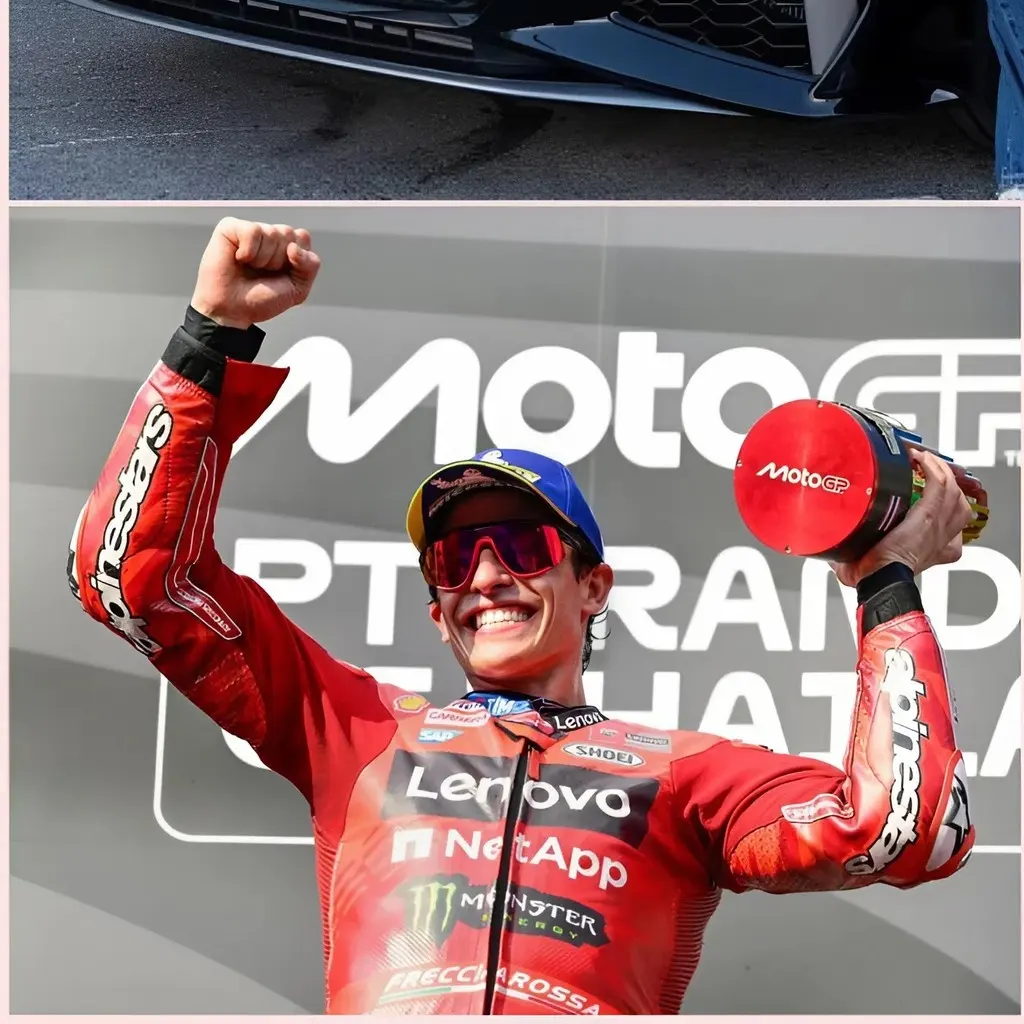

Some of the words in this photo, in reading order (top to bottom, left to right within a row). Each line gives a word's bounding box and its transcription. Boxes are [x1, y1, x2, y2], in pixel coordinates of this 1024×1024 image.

[756, 462, 850, 495] MotoGP
[234, 538, 421, 646] PT
[592, 543, 1021, 652] RAND
[575, 744, 633, 765] SHOEI
[405, 765, 632, 819] Lenovo
[445, 829, 628, 891] NetApp
